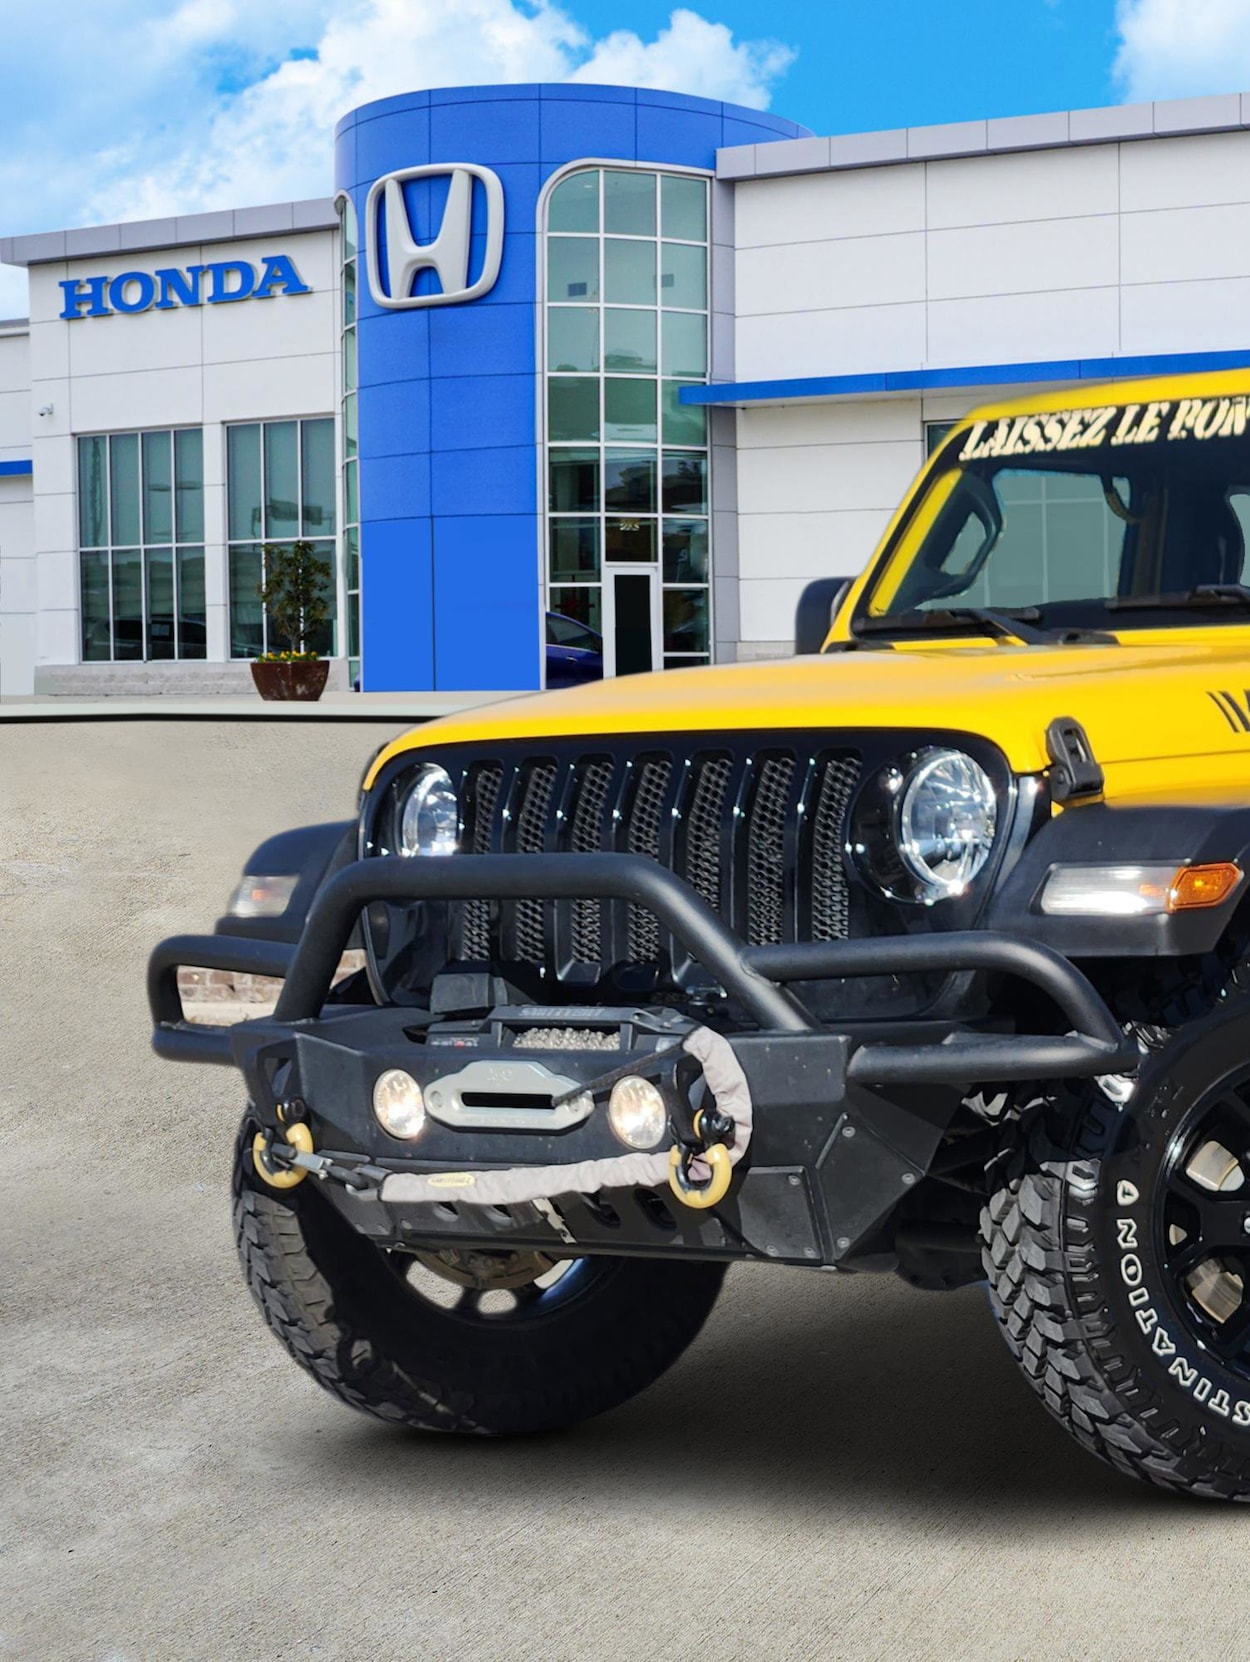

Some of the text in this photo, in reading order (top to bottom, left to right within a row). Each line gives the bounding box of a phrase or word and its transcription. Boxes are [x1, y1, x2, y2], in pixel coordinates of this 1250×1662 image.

[58, 254, 312, 321] HONDA
[958, 406, 1118, 461] LAISSEZ
[1110, 402, 1170, 446] LE
